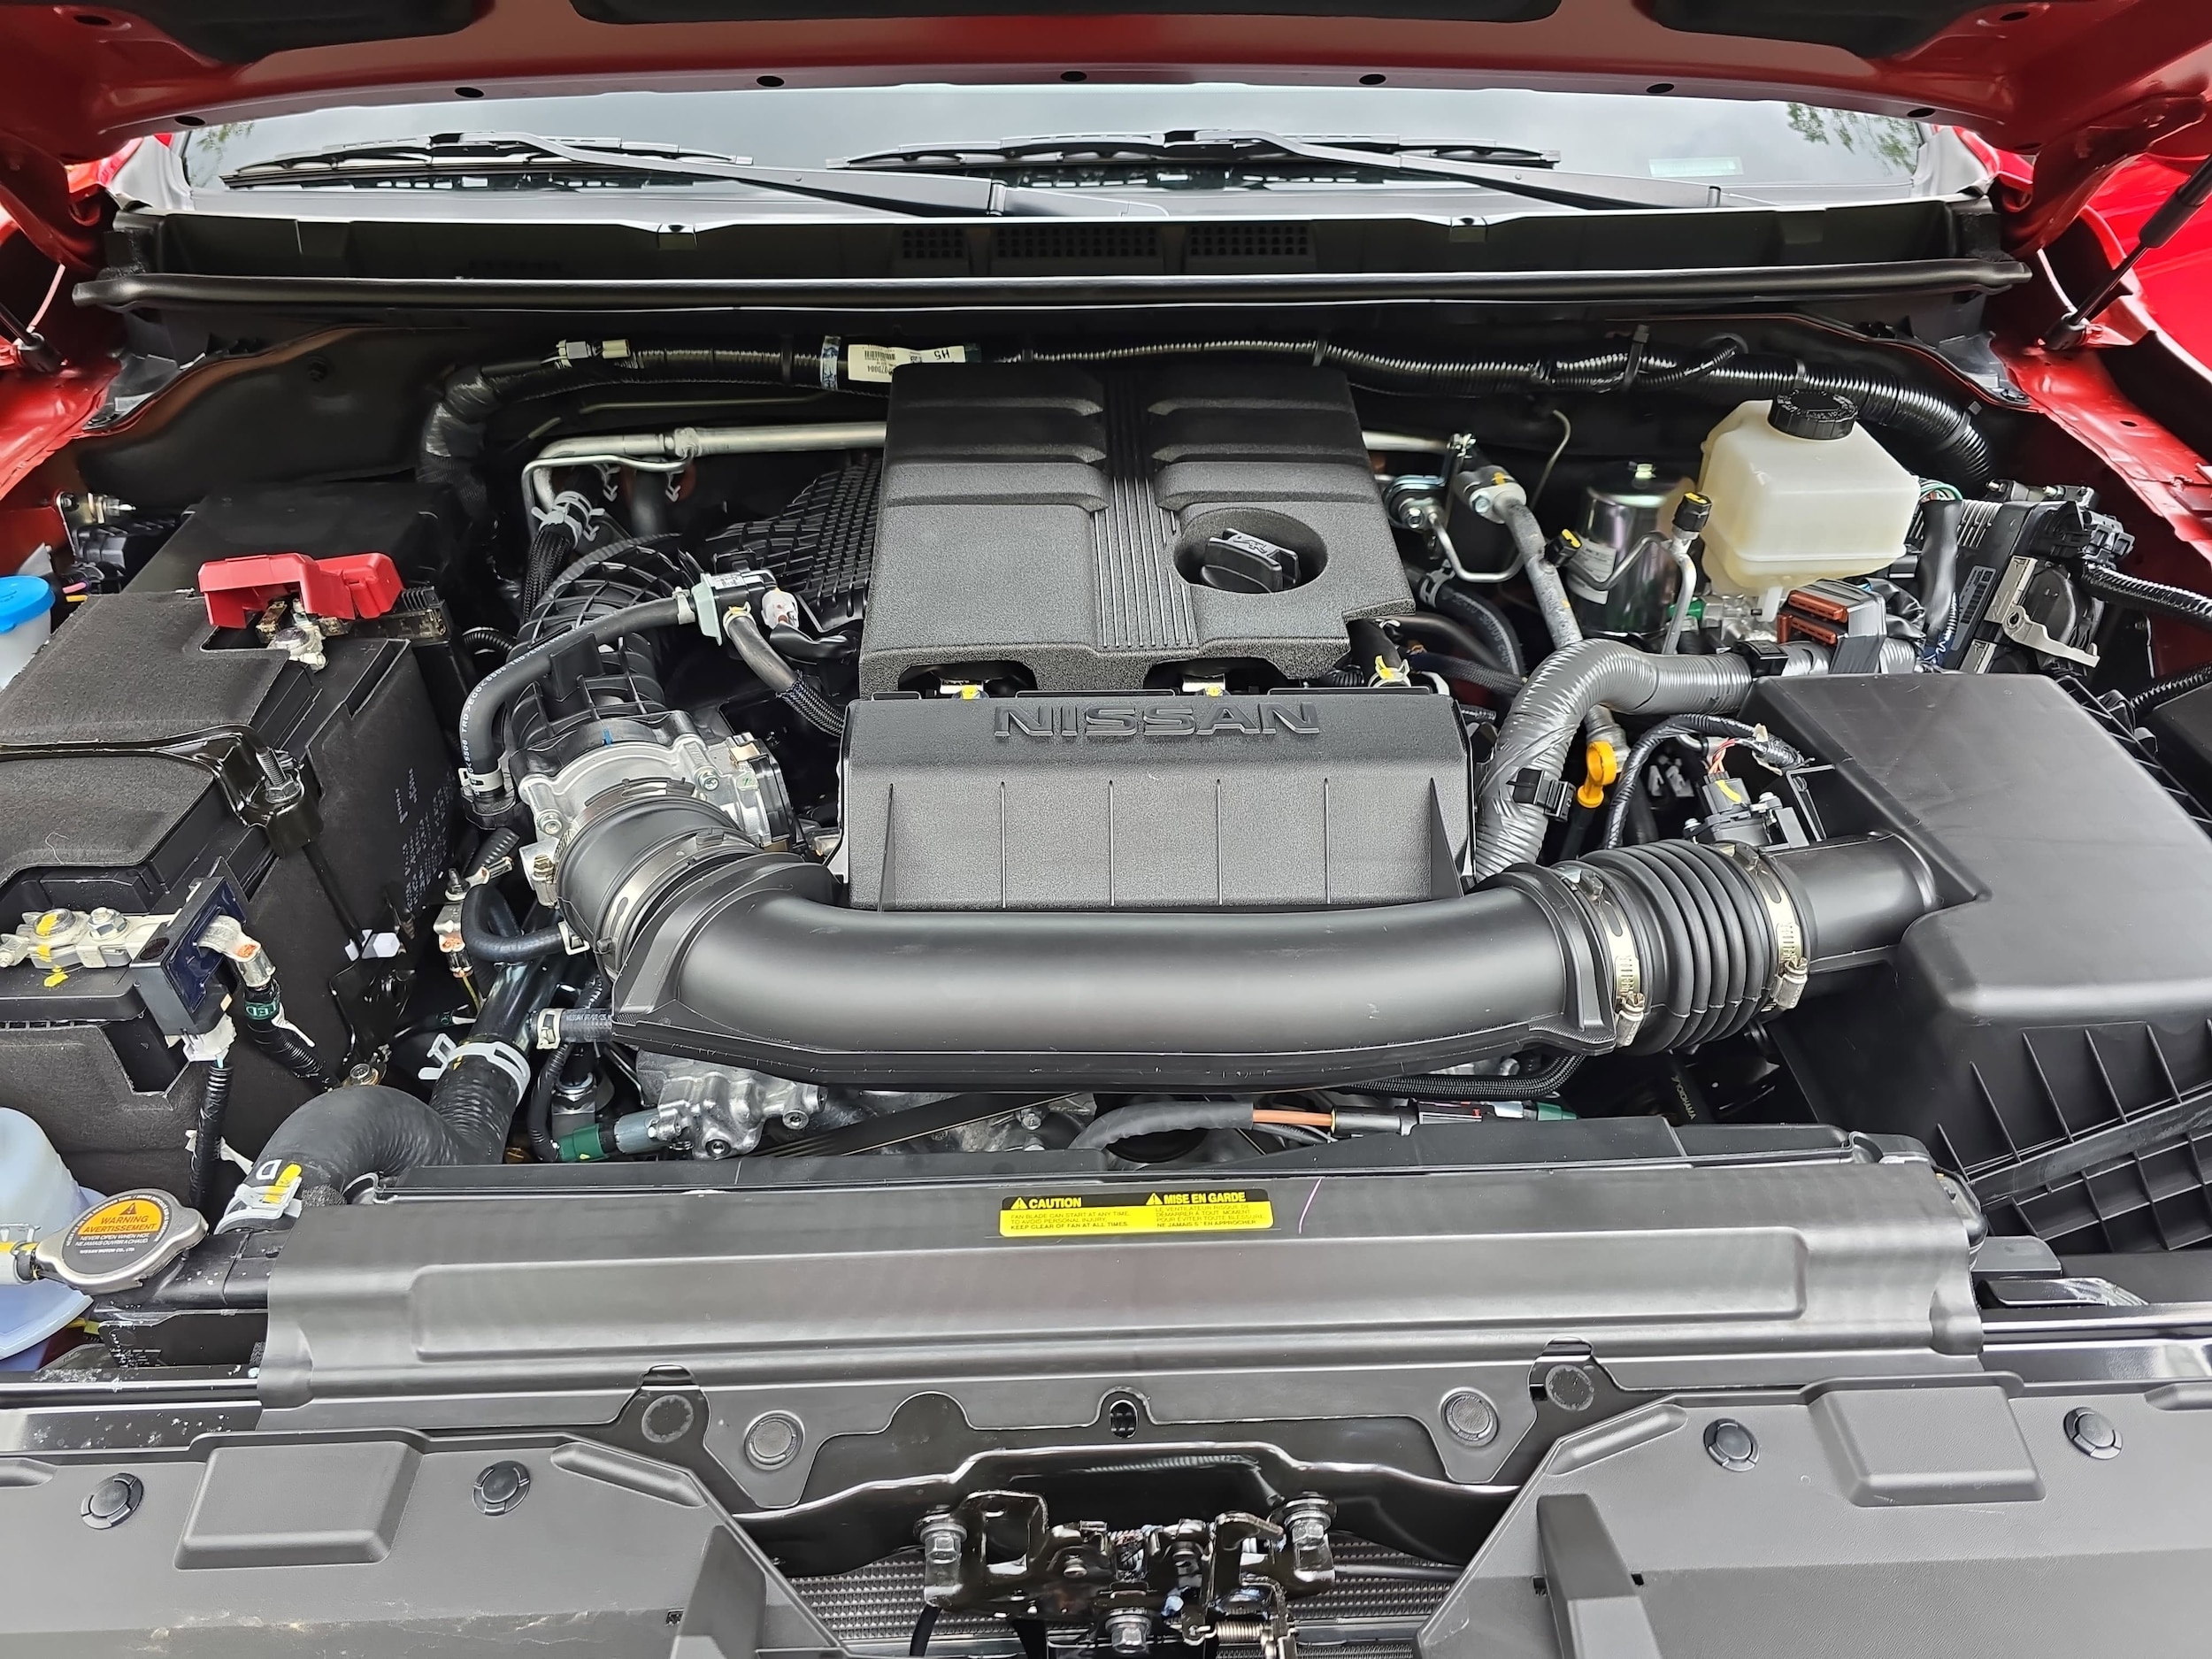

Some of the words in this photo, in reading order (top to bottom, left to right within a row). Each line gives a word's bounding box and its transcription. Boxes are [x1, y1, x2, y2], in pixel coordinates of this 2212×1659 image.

[933, 349, 950, 361] H5
[994, 701, 1320, 737] NISSAN
[1028, 1196, 1082, 1209] CAUTION
[1163, 1194, 1190, 1205] MISE
[1191, 1193, 1207, 1204] EN
[1208, 1191, 1247, 1203] GARDE
[101, 1216, 149, 1225] WARNING
[82, 1223, 157, 1233] AVERTISSEMENT
